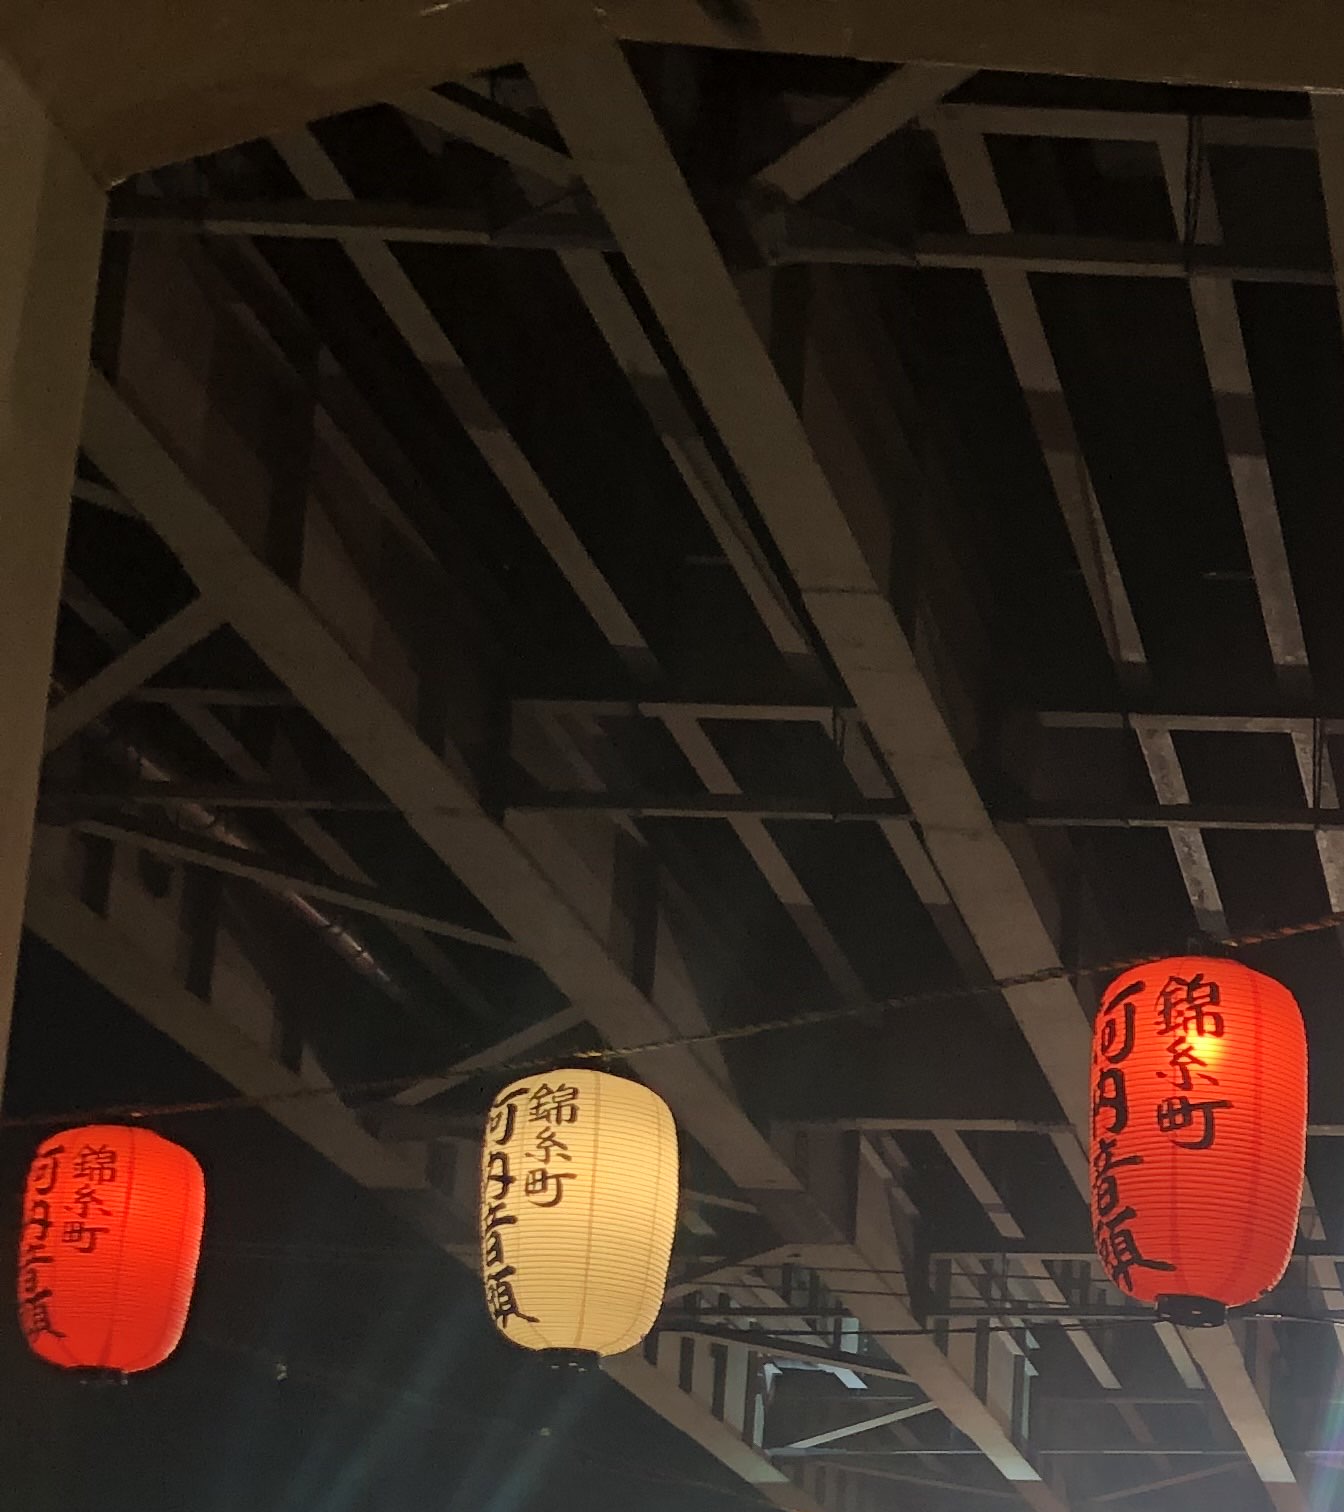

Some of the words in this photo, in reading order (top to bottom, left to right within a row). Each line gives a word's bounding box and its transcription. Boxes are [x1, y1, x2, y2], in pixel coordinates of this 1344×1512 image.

[1153, 973, 1233, 1151] 錦糸町
[61, 1142, 118, 1254] 錦糸町
[523, 1082, 579, 1208] 錦糸町
